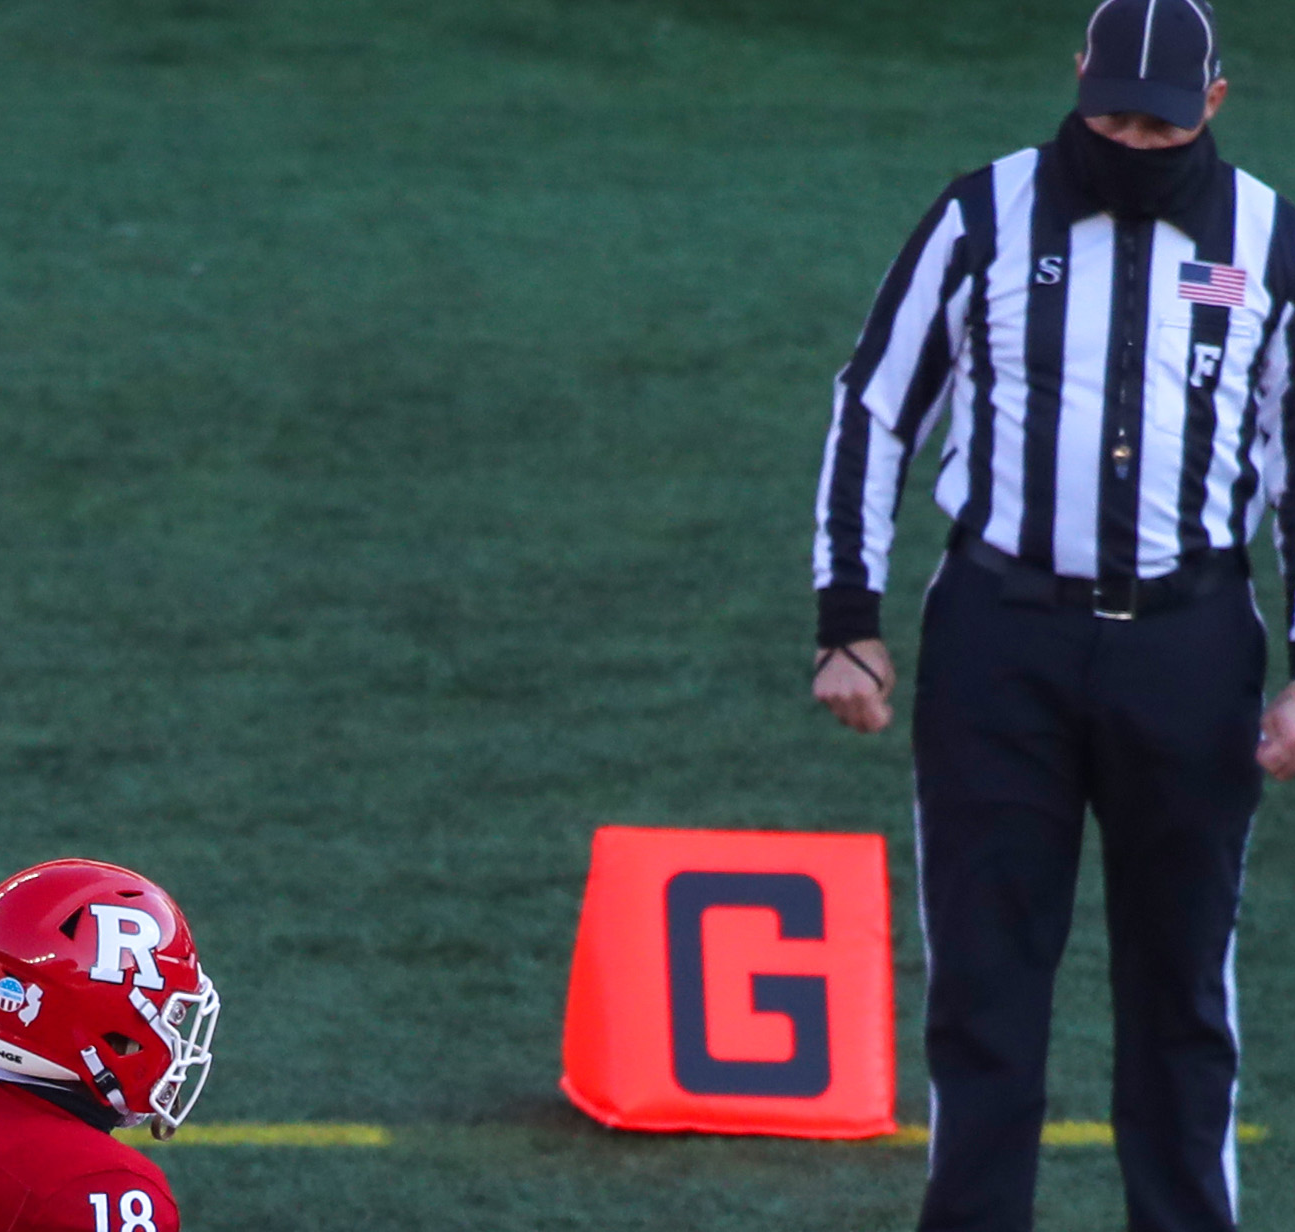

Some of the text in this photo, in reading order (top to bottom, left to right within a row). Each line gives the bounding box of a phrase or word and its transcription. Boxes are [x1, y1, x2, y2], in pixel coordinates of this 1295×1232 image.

[1035, 256, 1063, 285] S
[1190, 342, 1223, 388] F
[89, 903, 165, 991] R
[665, 870, 831, 1099] G
